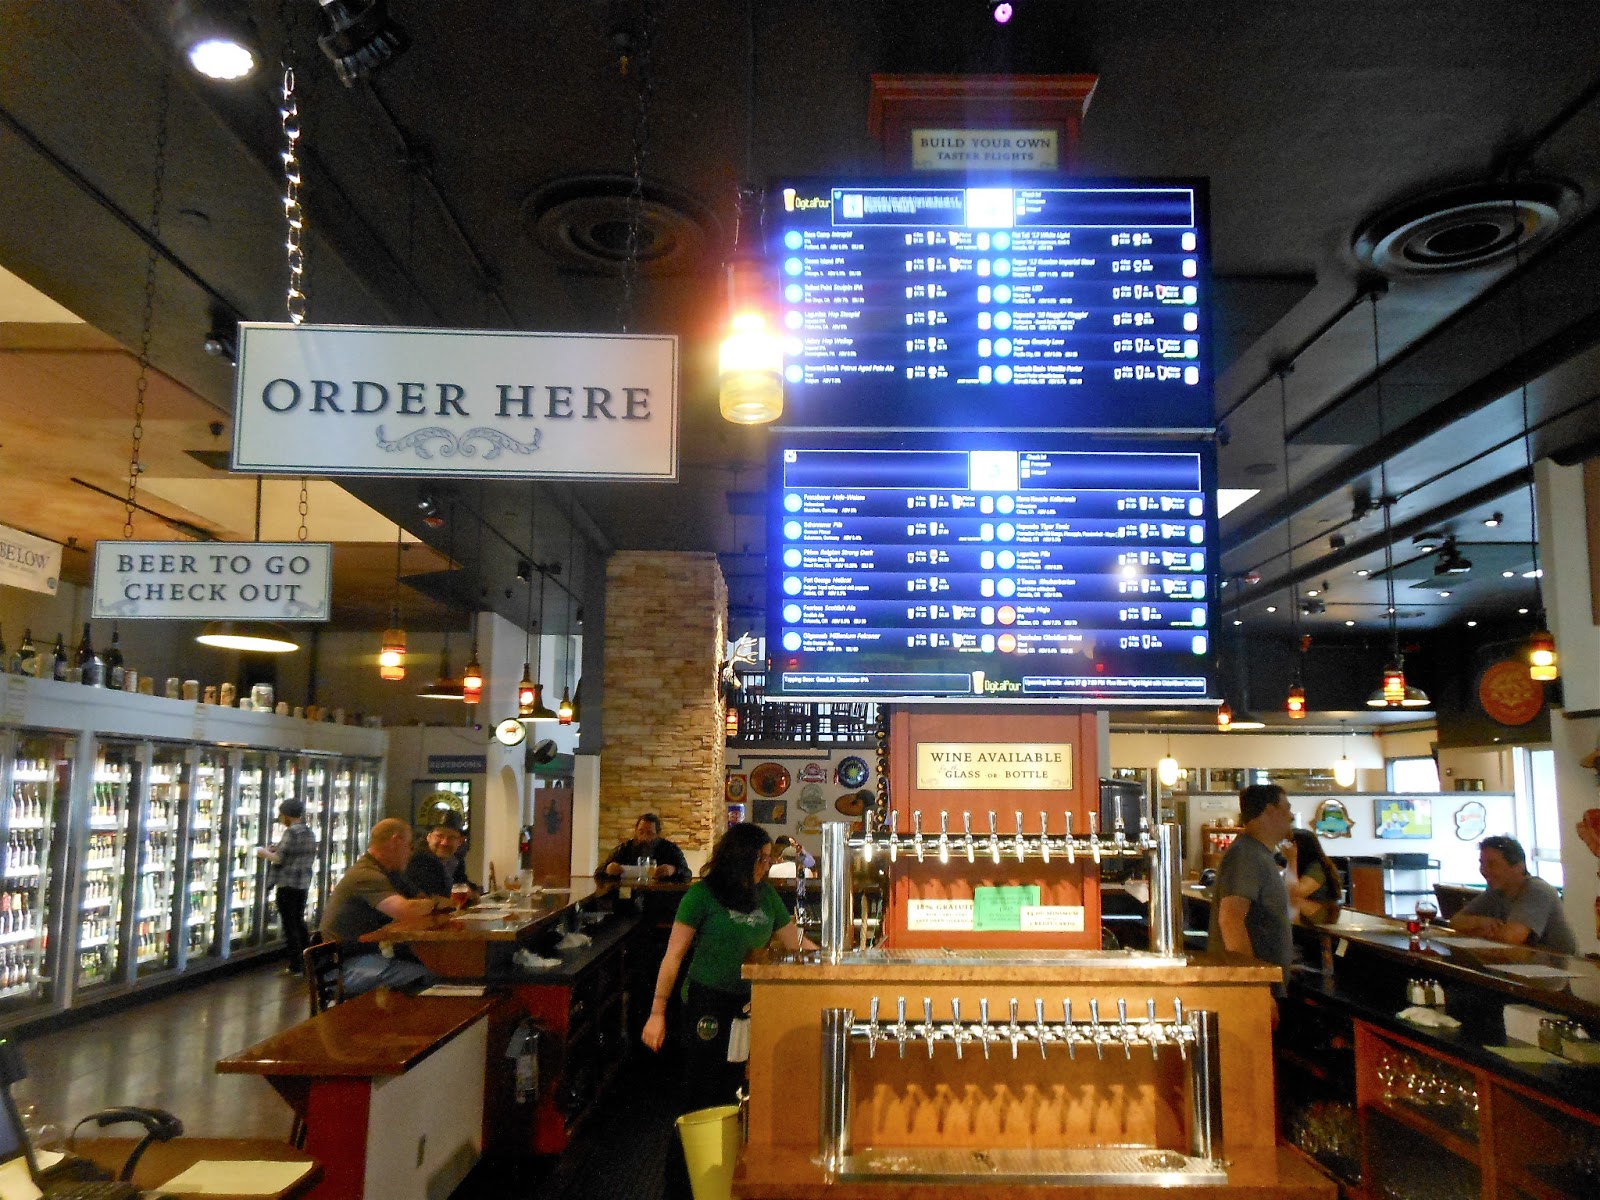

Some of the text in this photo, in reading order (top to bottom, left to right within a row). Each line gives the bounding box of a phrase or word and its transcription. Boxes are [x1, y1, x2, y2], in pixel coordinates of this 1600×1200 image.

[921, 138, 1050, 148] BUILD YOUR OWN
[938, 152, 1034, 161] TASTER FLIGHTS
[262, 378, 652, 422] ORDER HERE
[0, 541, 46, 569] BELOW
[117, 554, 310, 575] BEER TO GO
[124, 583, 302, 602] CHECK OUT
[930, 752, 1062, 763] WINE AVAILABLE
[945, 770, 981, 779] GLASS
[1005, 770, 1048, 779] BOTTLE
